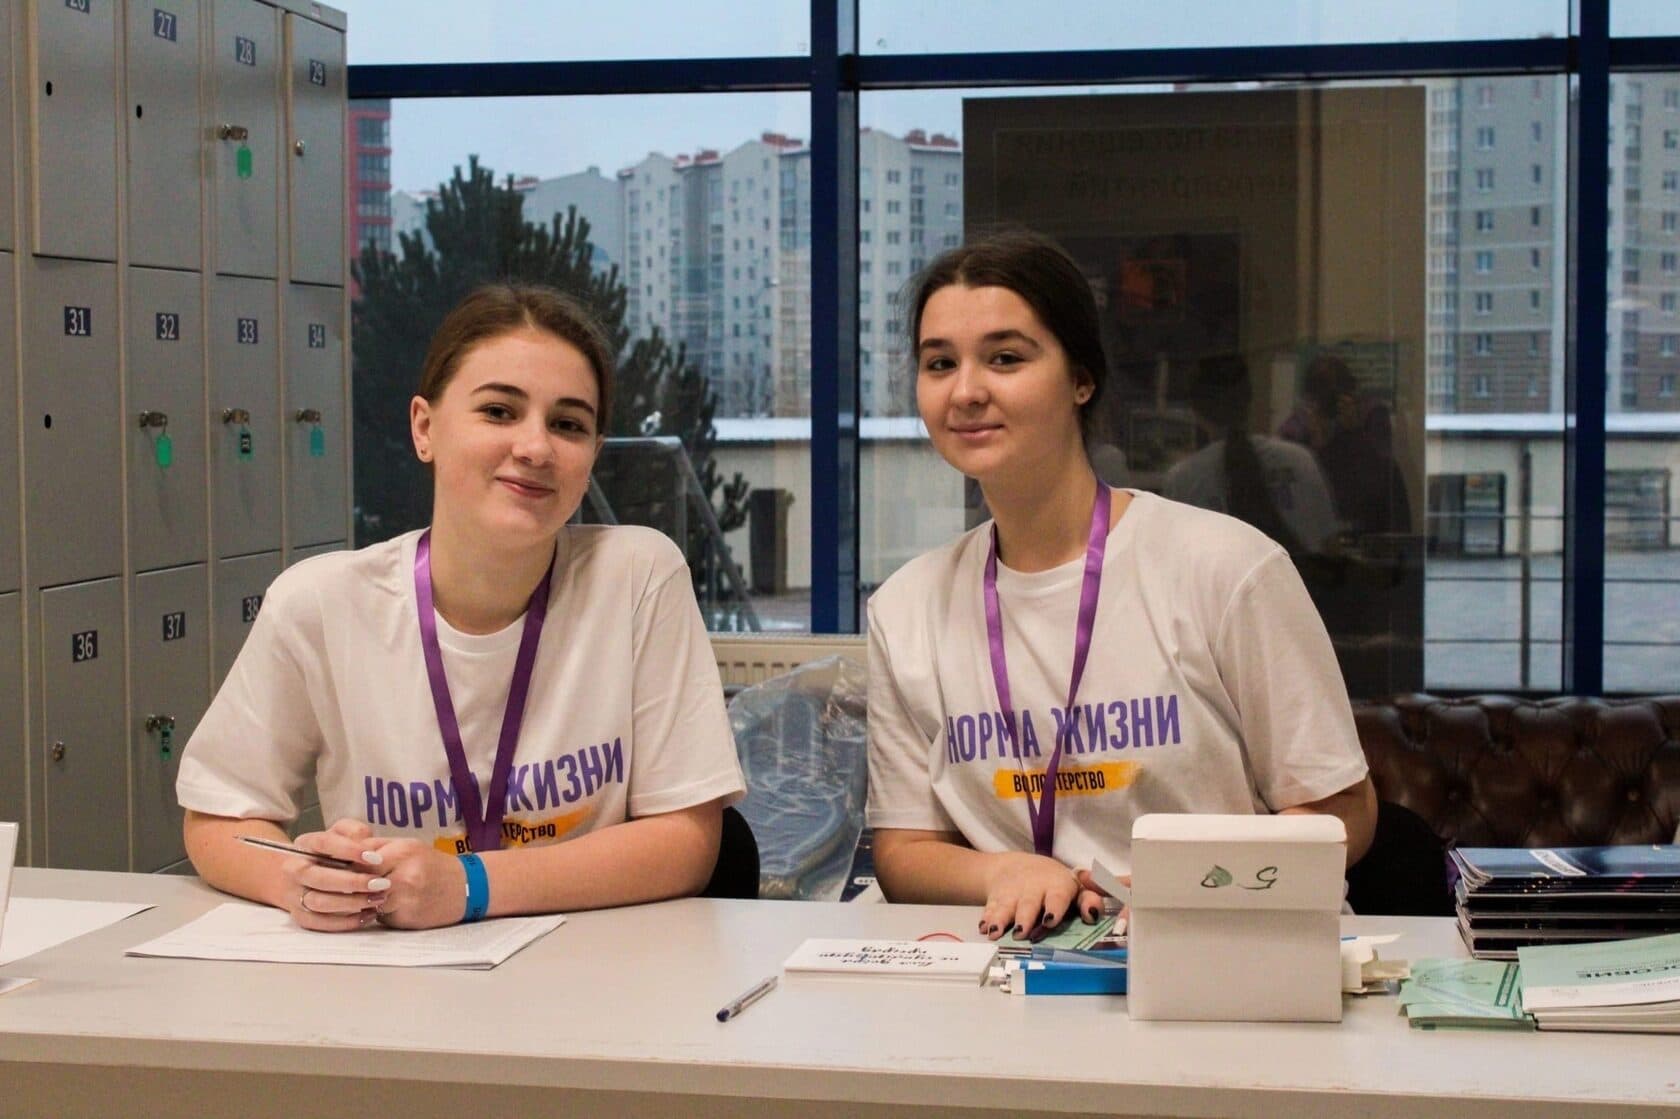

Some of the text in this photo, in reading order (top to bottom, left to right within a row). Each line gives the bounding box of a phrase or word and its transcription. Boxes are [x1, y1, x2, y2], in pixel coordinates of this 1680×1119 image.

[157, 11, 173, 38] 27
[239, 39, 252, 64] 28
[311, 62, 324, 85] 29
[69, 308, 87, 335] 31
[159, 314, 176, 339] 32
[240, 319, 255, 343] 33
[311, 326, 323, 347] 34
[246, 598, 259, 621] 38
[167, 613, 182, 639] 37
[76, 632, 94, 660] 36
[946, 694, 1182, 765] НОРМА ЖИЗНИ
